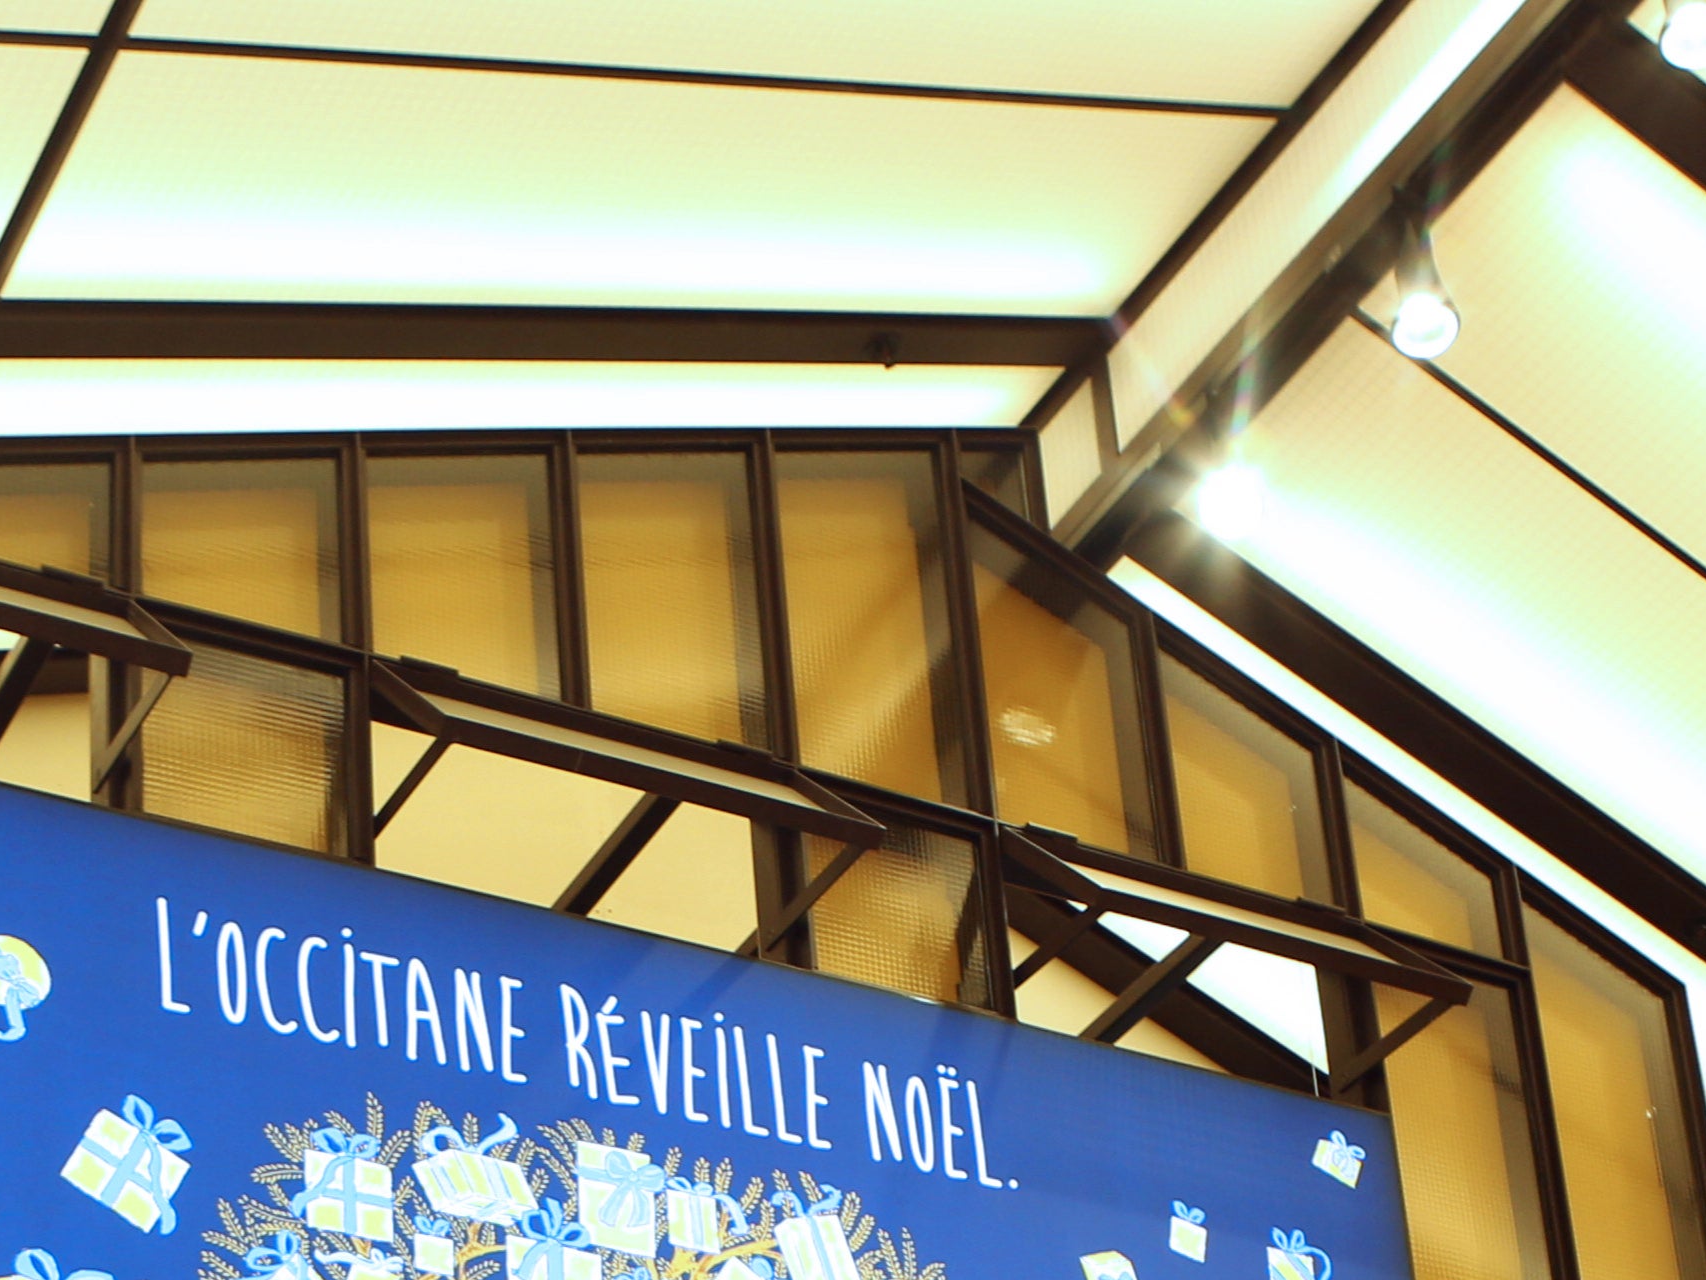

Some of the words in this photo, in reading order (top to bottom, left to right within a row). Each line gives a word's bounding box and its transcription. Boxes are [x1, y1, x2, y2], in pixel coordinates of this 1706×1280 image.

[155, 897, 526, 1085] L'OCCITANE
[559, 983, 831, 1151] RÉVEILLE
[863, 1059, 1019, 1190] NOËL.
